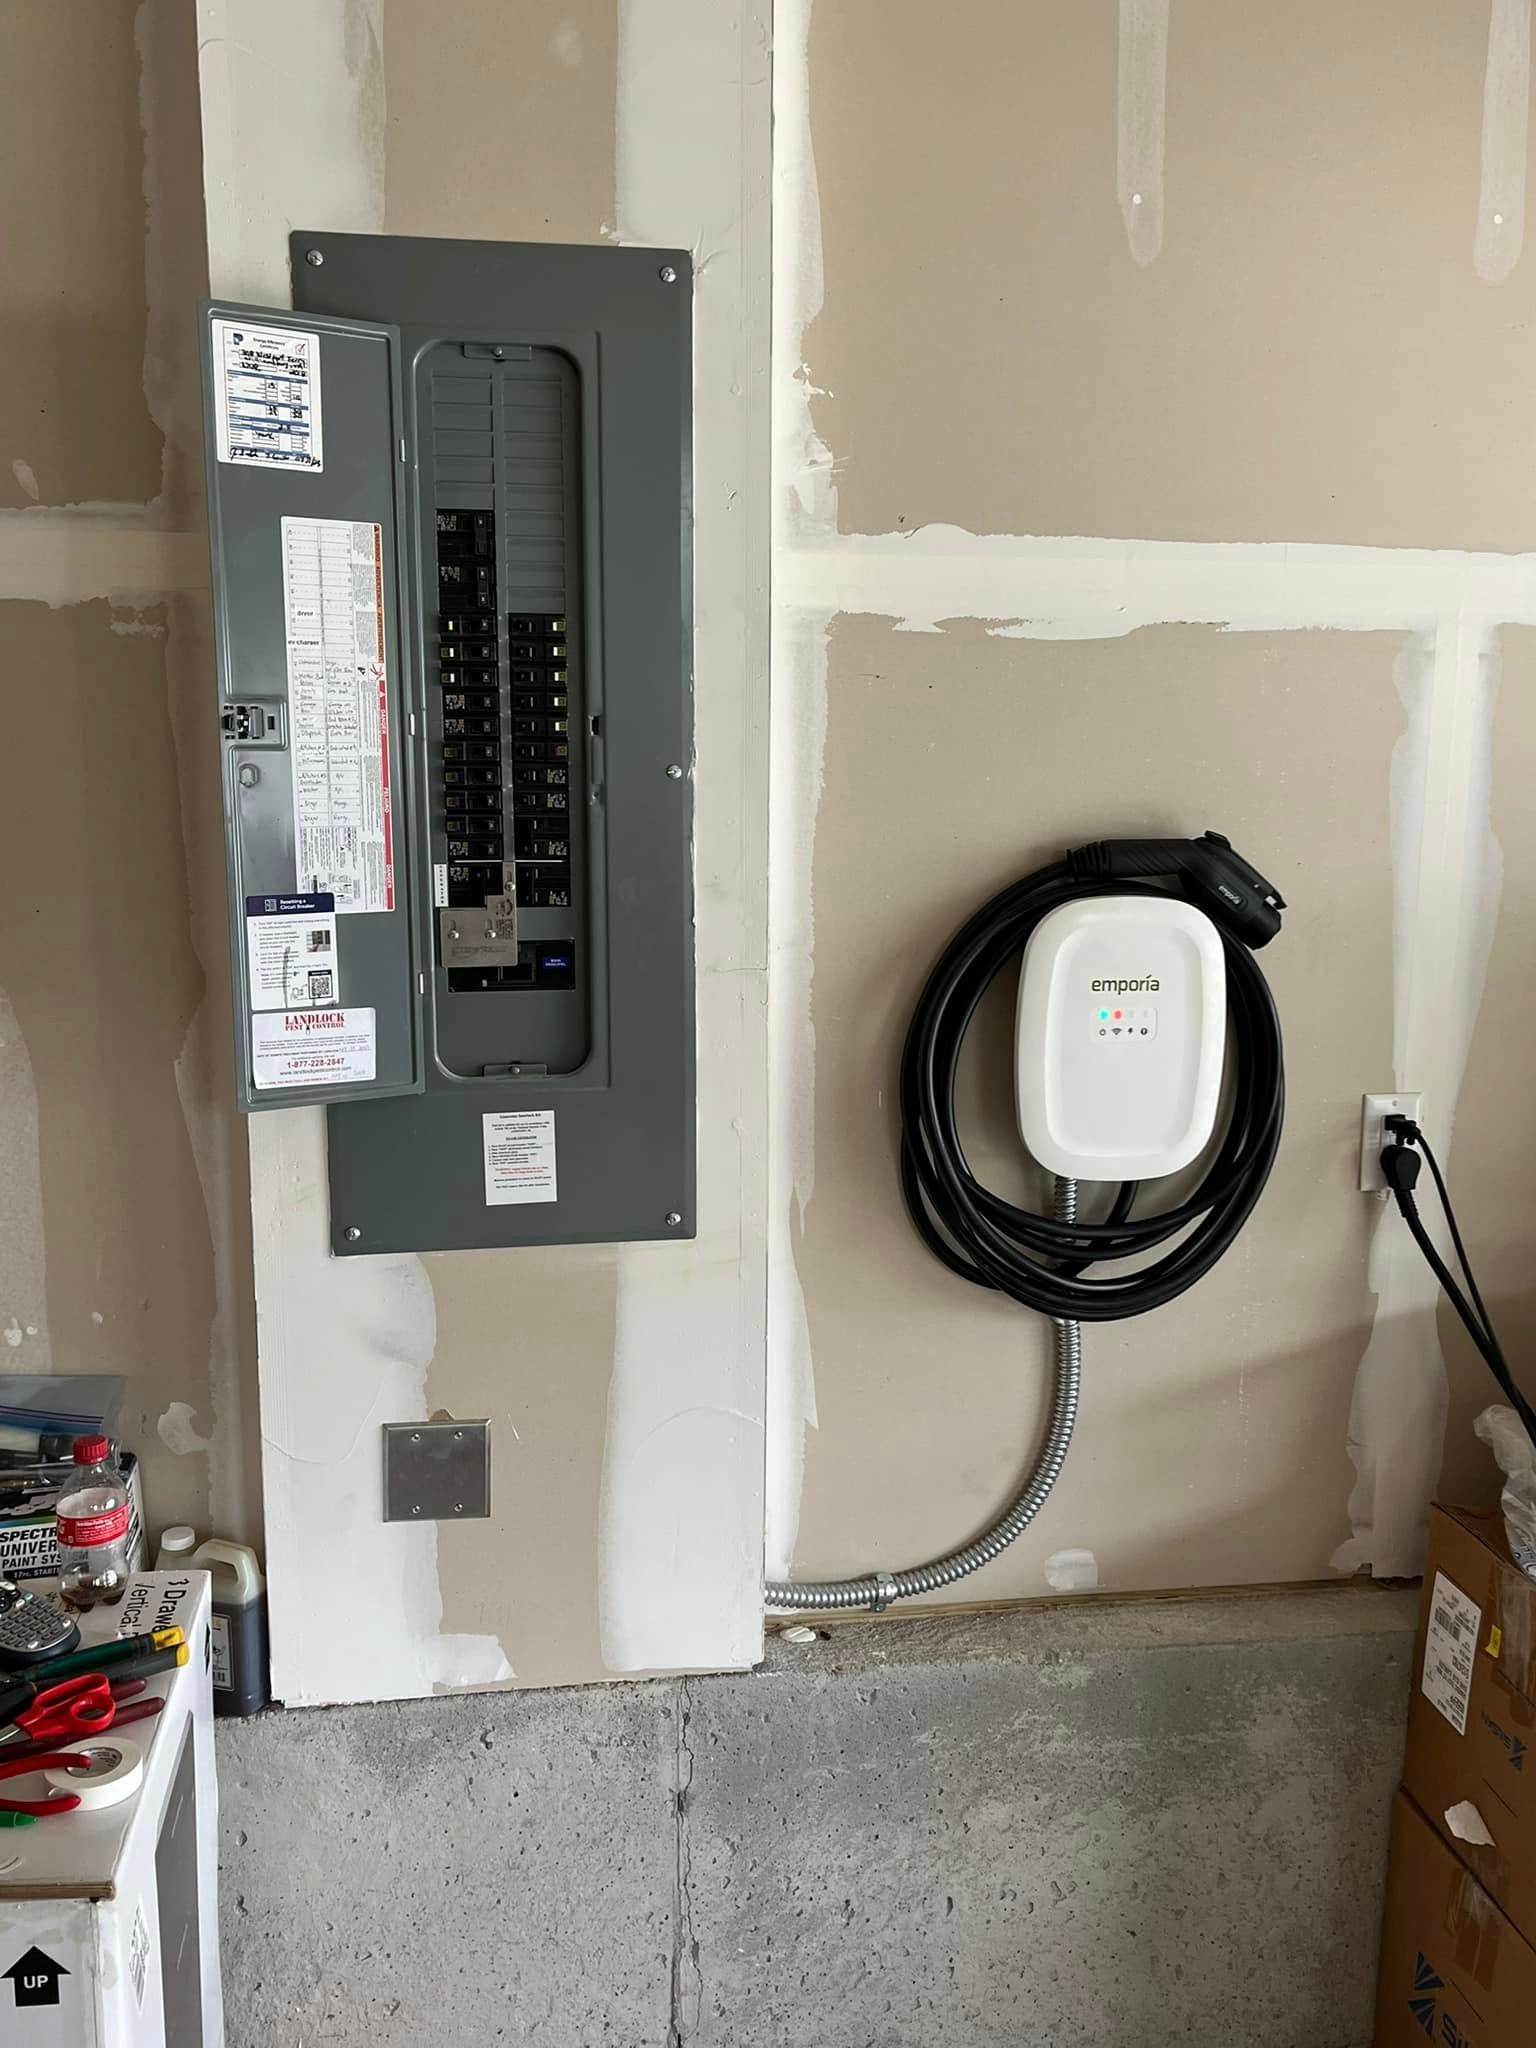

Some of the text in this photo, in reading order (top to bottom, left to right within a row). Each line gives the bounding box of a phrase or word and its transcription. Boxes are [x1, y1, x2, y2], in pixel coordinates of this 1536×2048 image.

[285, 1013, 345, 1025] LANDLOCK
[285, 1022, 345, 1032] PEST CONTROL
[287, 1058, 345, 1069] 1-877-228-2847
[0, 1527, 57, 1543] SPECTR
[0, 1540, 57, 1557] UNIVER
[2, 1553, 62, 1569] PAINT SYS
[34, 1567, 59, 1577] START
[151, 1590, 187, 1632] Drawe
[23, 1975, 49, 1989] UP
